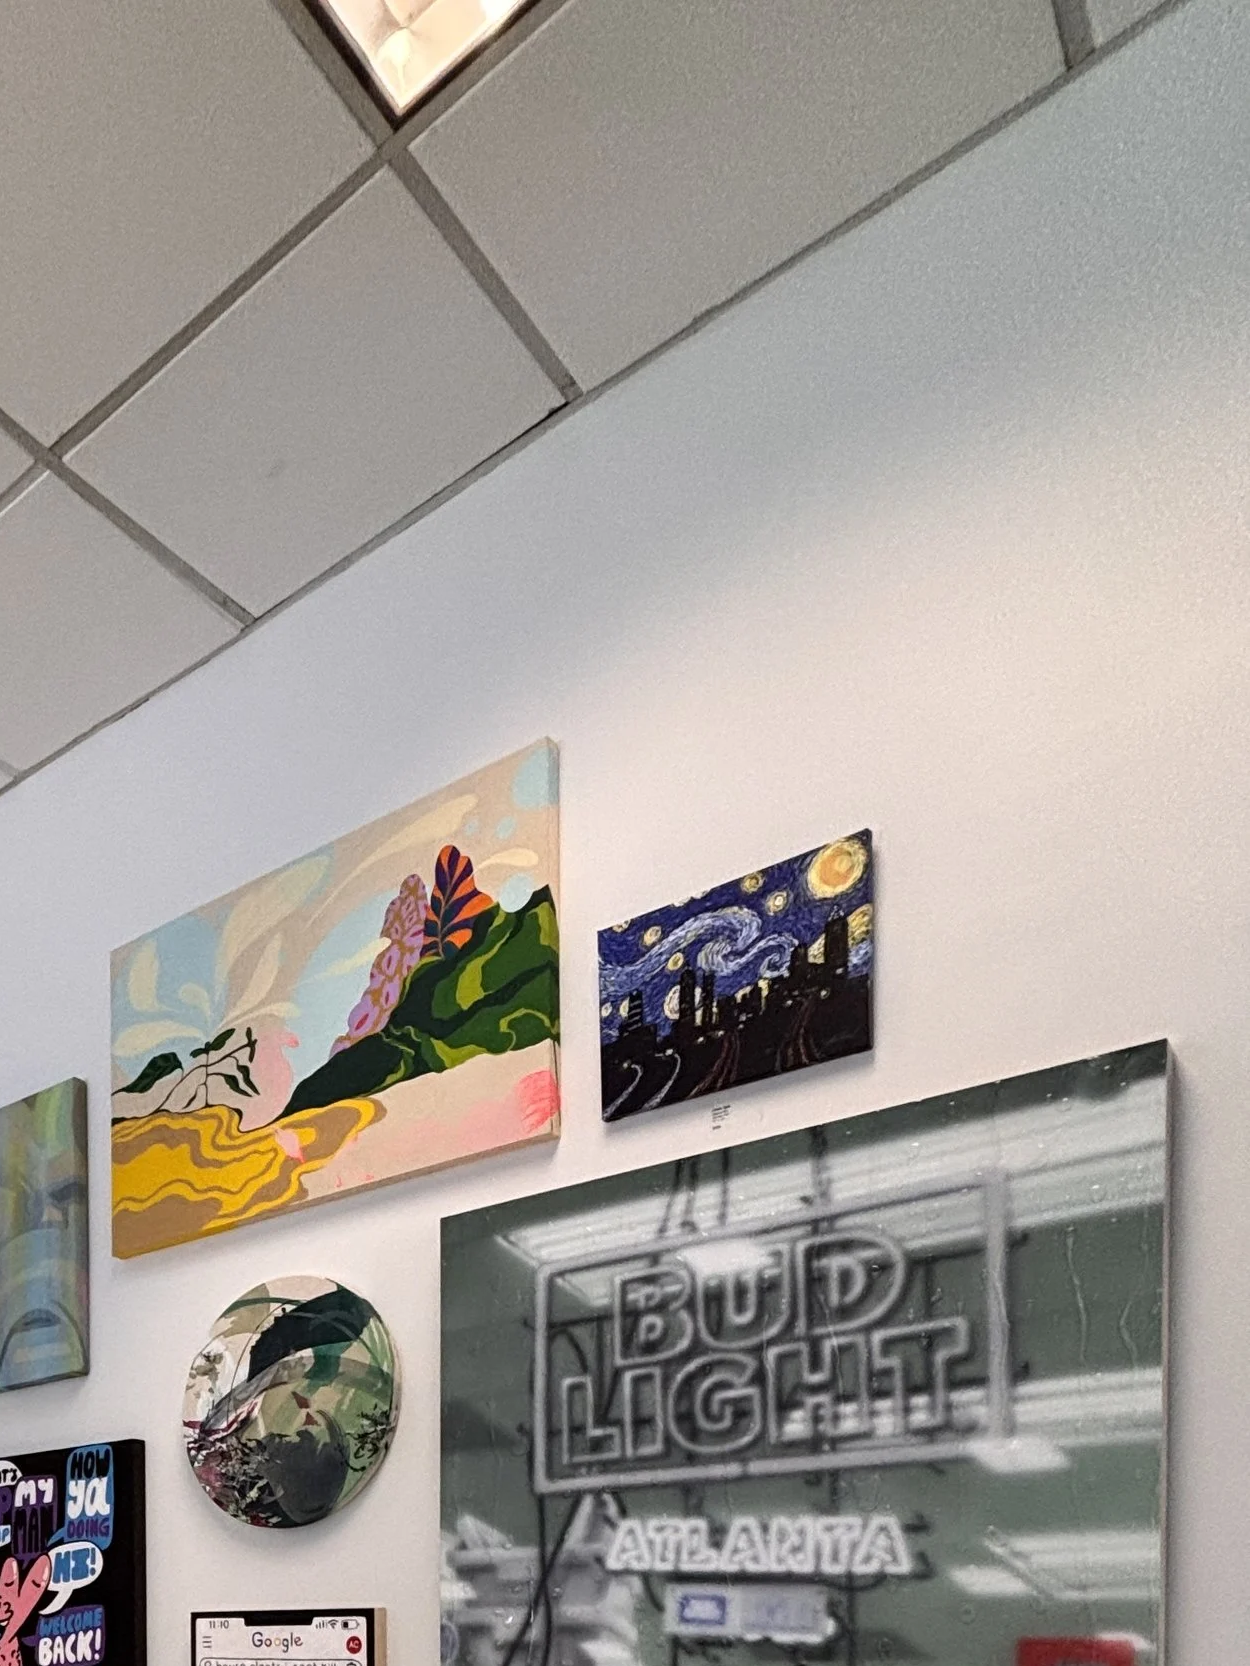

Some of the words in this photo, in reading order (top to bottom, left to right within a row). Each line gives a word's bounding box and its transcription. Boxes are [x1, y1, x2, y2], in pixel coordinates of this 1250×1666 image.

[613, 1227, 907, 1368] BUD
[561, 1315, 969, 1465] LIGHT
[70, 1449, 111, 1480] HOW
[14, 1478, 54, 1507] MY
[14, 1503, 54, 1555] MAN
[66, 1518, 110, 1539] DOING
[605, 1514, 913, 1575] ATLANTA
[52, 1547, 97, 1584] HI!
[40, 1607, 103, 1634] WELCOME
[209, 1620, 230, 1629] 11:10
[38, 1628, 102, 1666] BACK!
[252, 1632, 304, 1653] Google
